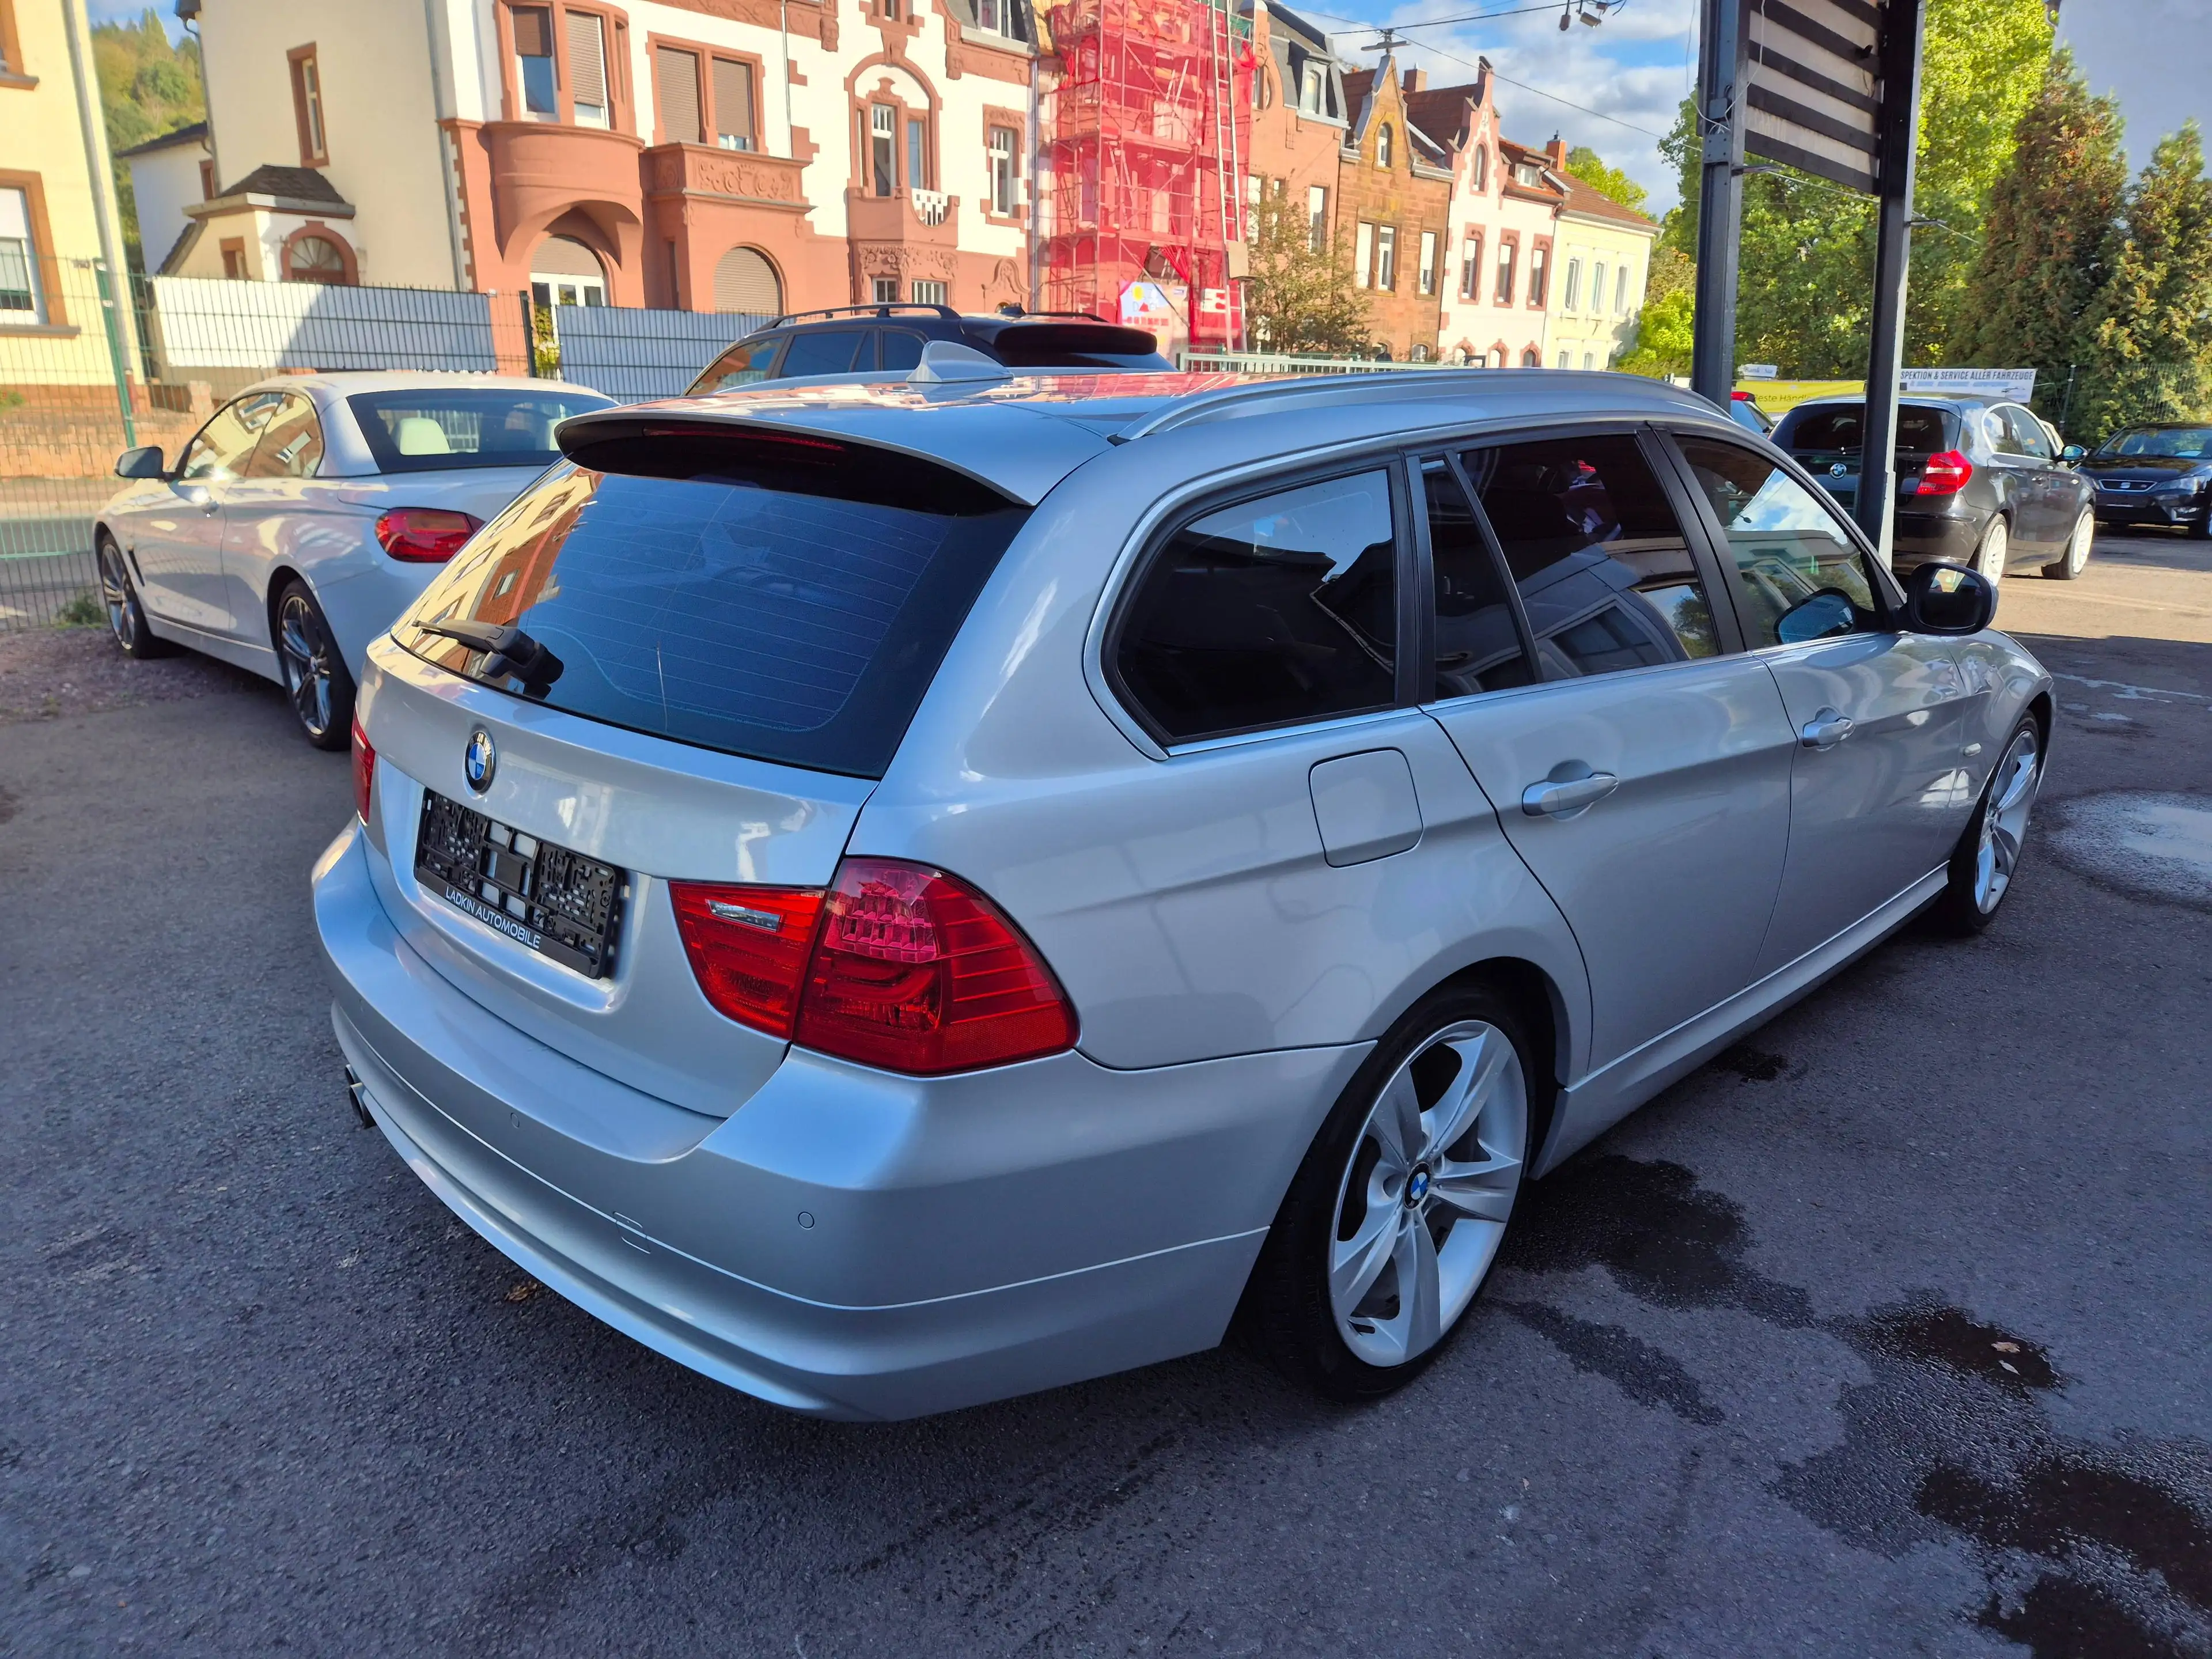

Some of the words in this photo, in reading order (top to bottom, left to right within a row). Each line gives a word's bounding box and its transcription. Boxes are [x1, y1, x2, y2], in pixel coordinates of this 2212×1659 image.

[1934, 371, 1938, 380] &
[1940, 371, 1968, 380] SERVICE
[1970, 371, 1991, 380] ALLER
[1993, 371, 2033, 380] FAHRZEUGE
[445, 886, 476, 914] LADKIN
[476, 907, 541, 950] AUTOMOBILE
